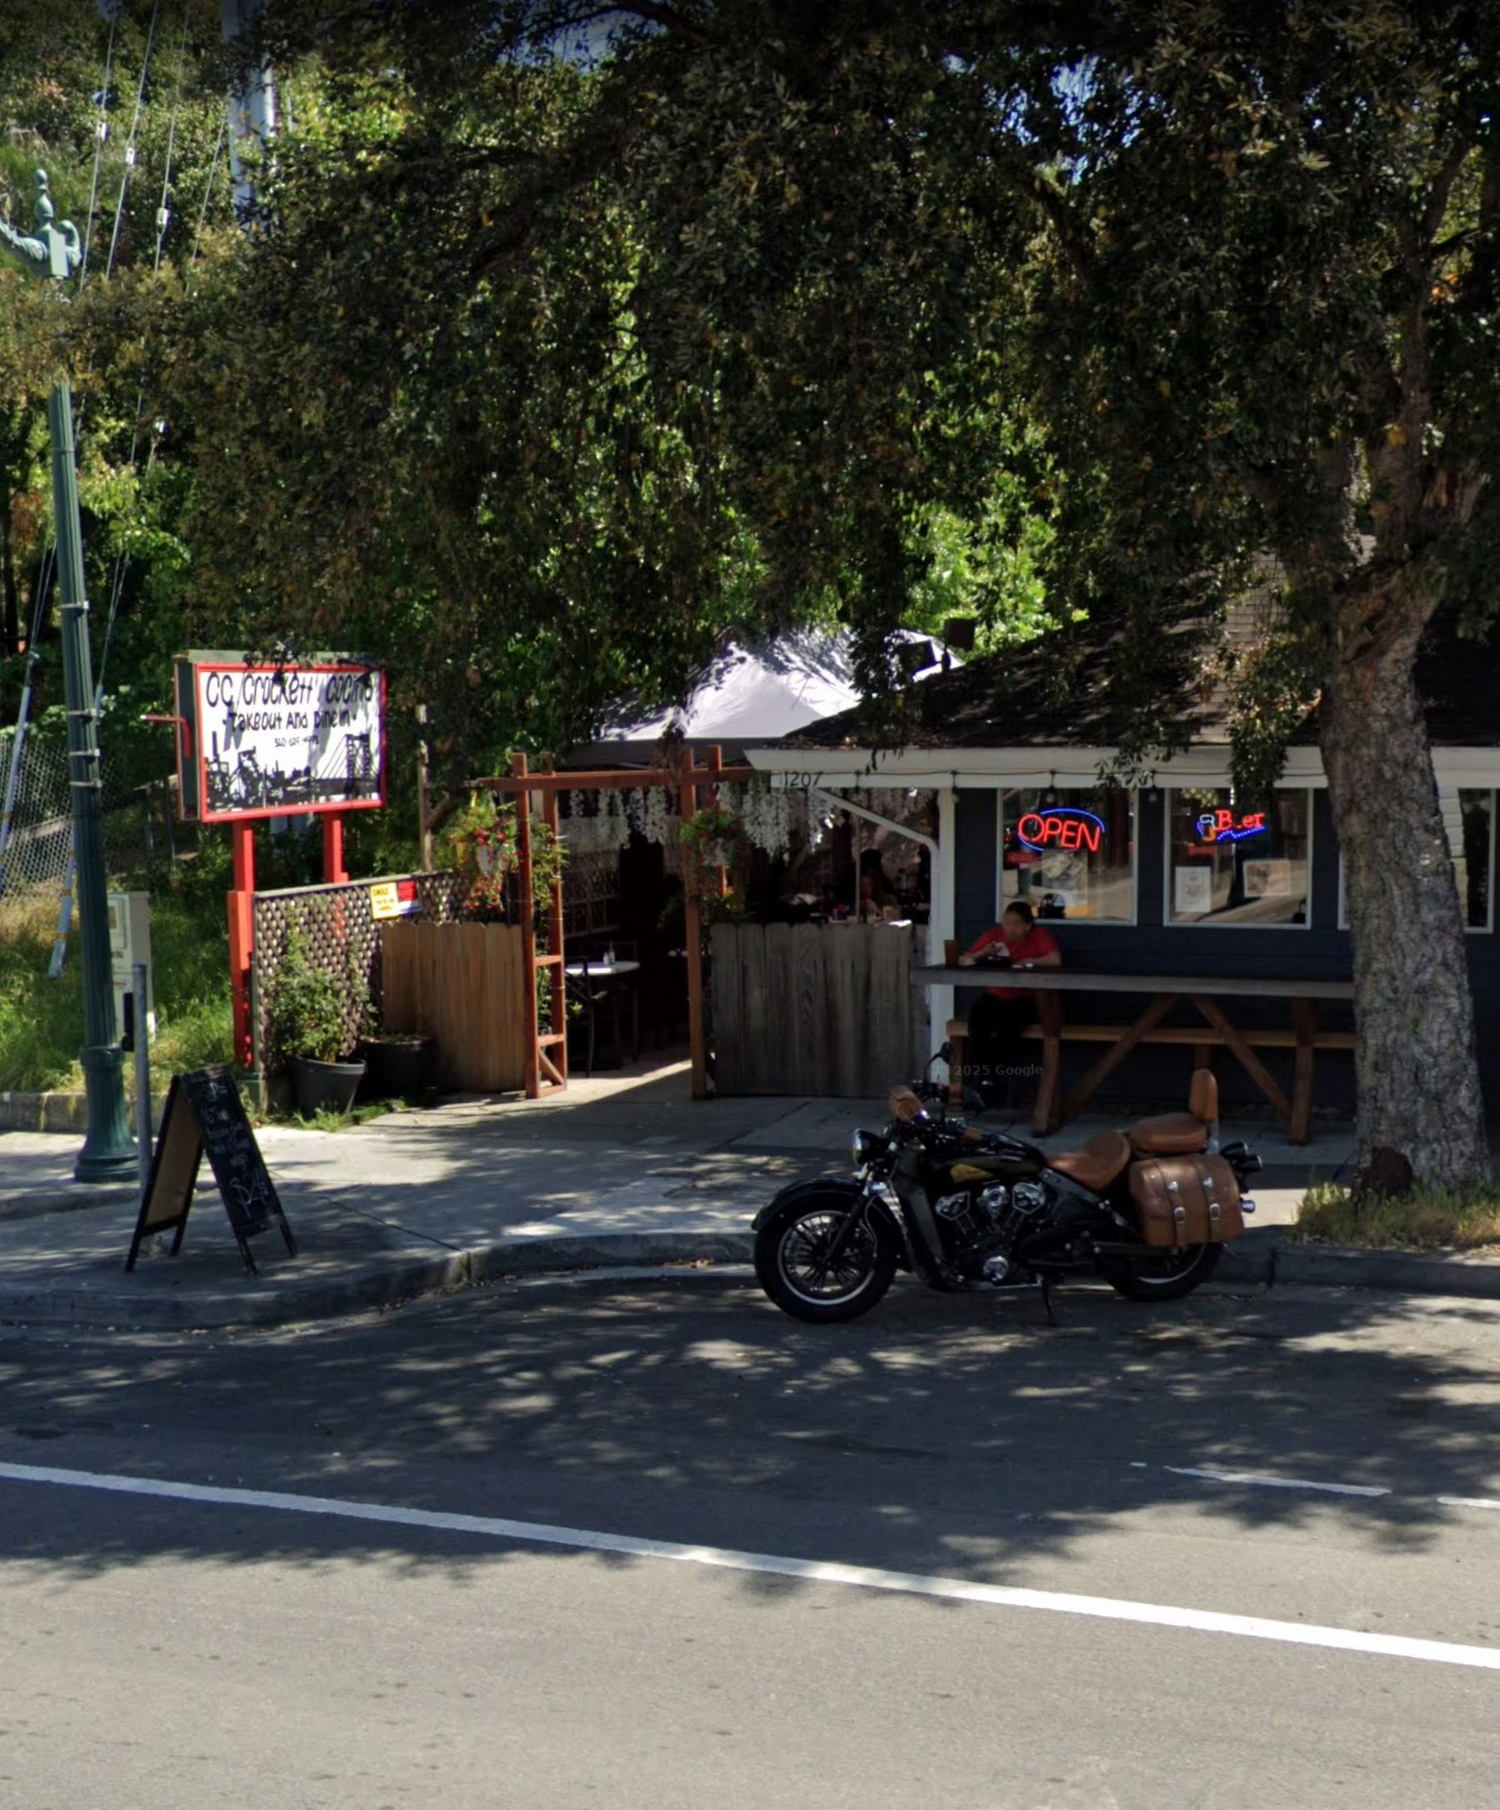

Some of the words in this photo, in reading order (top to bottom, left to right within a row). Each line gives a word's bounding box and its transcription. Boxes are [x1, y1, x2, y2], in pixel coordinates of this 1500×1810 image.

[206, 672, 233, 707] CC
[286, 711, 308, 729] And
[784, 771, 823, 787] 1207
[1214, 808, 1266, 831] Ber
[1018, 813, 1102, 852] OPEN
